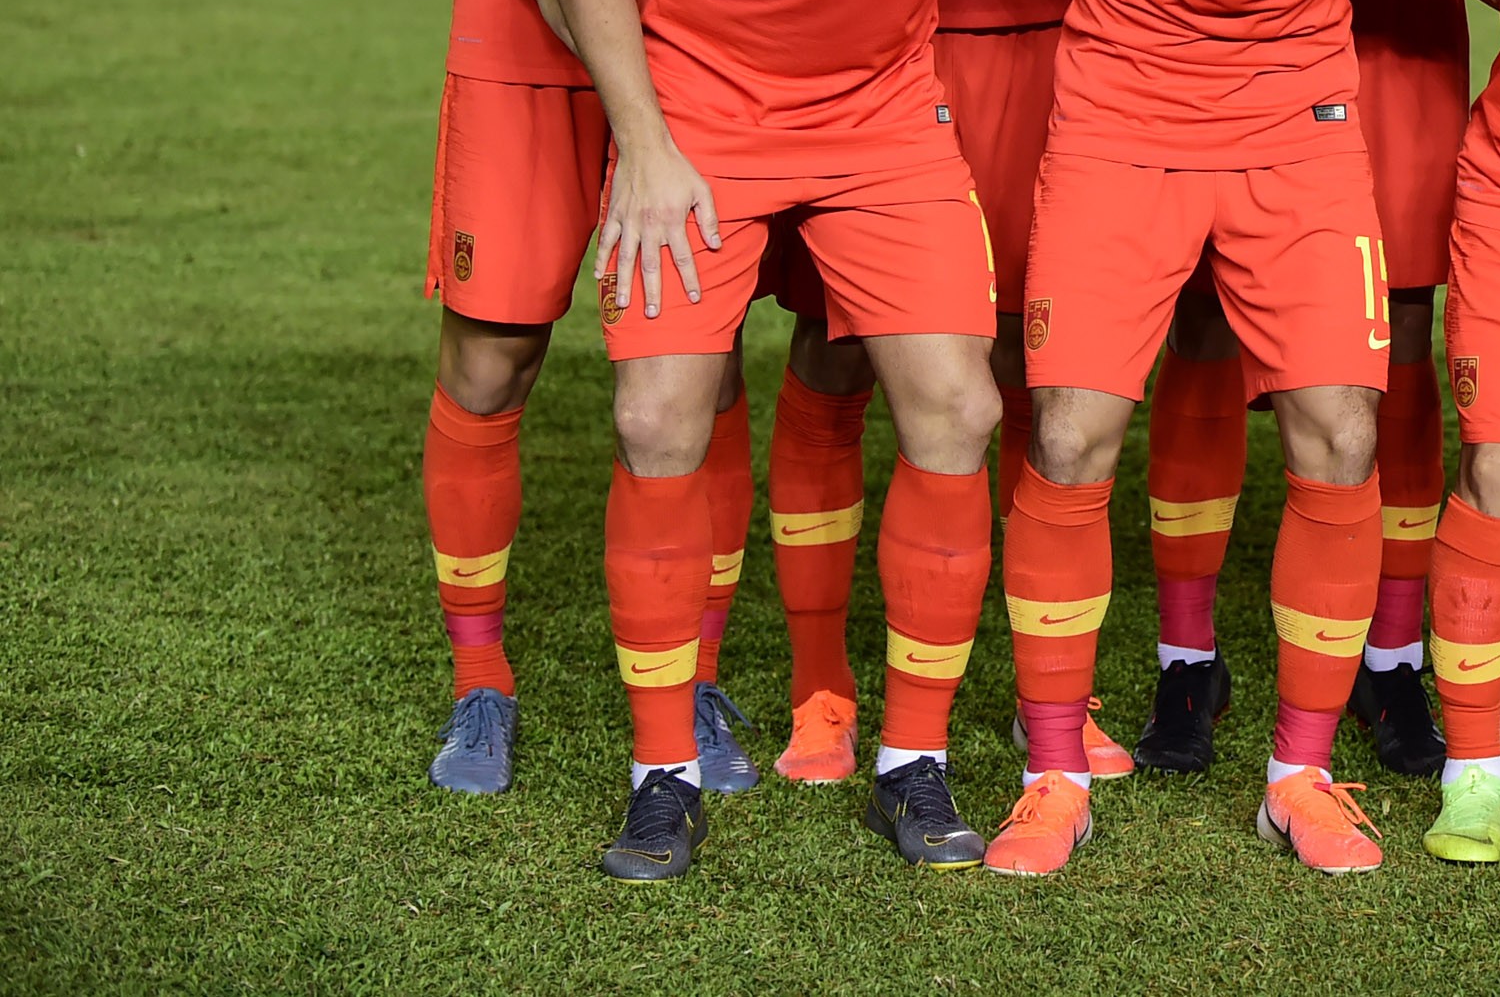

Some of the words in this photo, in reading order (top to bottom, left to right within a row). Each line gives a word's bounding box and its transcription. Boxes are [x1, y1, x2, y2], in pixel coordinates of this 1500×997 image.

[456, 233, 474, 247] CFA
[1029, 301, 1050, 313] CFA
[1455, 359, 1477, 370] CFA
